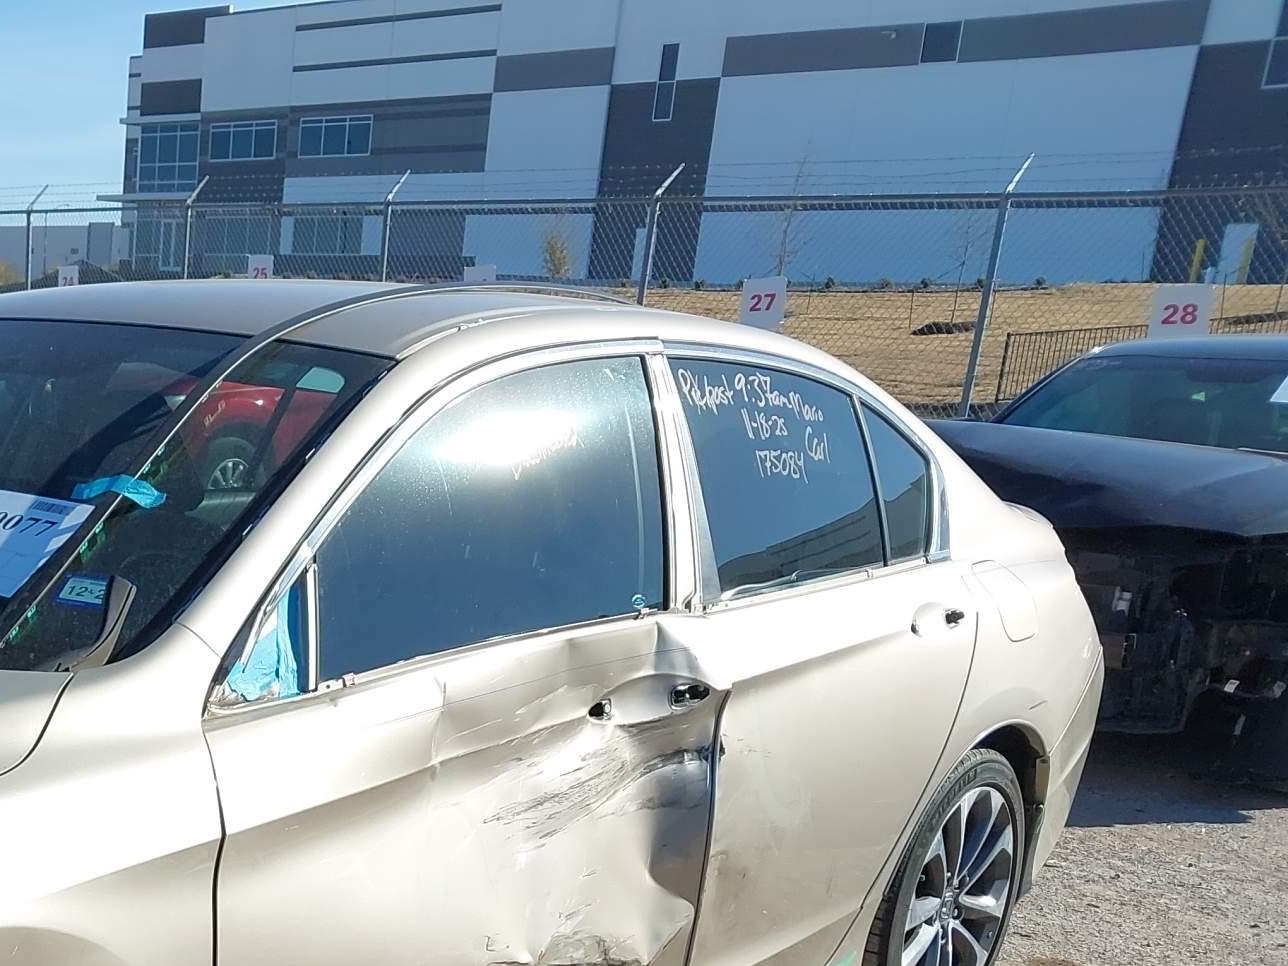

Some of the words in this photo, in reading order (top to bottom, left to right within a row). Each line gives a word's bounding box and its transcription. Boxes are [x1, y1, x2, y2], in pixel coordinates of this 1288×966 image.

[253, 266, 268, 279] 25
[749, 292, 777, 312] 27
[1160, 303, 1199, 325] 28
[755, 449, 809, 485] 175084
[68, 585, 88, 597] 12
